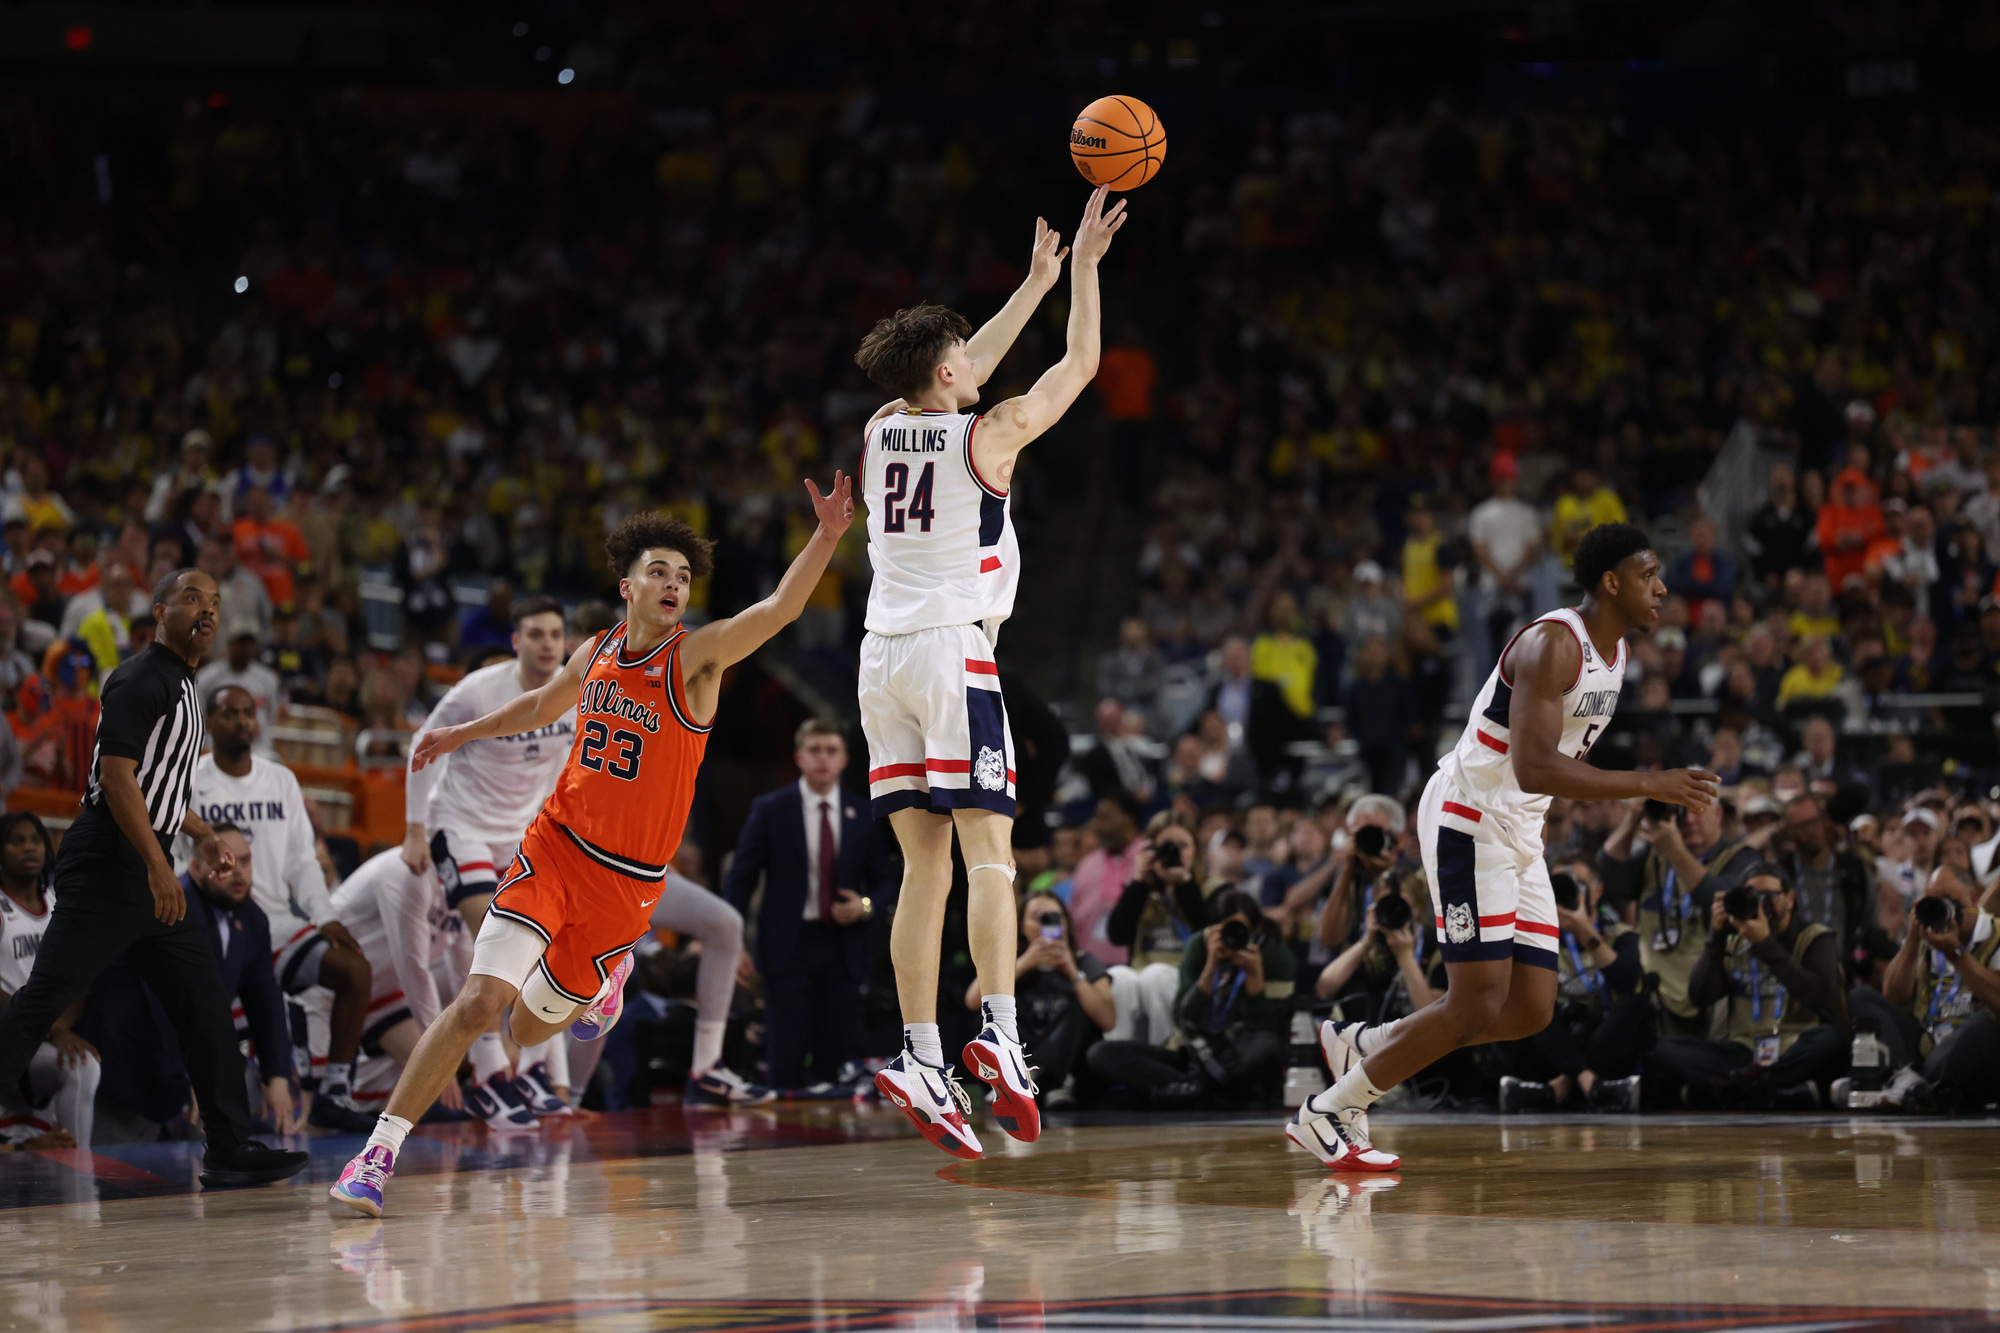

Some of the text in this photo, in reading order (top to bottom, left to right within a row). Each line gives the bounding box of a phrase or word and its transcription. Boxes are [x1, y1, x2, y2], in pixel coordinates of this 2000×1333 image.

[881, 428, 948, 453] MULLINS
[884, 461, 935, 534] 24
[580, 679, 661, 734] Illinois
[579, 718, 644, 781] 23
[1574, 722, 1600, 760] 5
[200, 802, 246, 823] LOCK
[250, 801, 263, 822] IT
